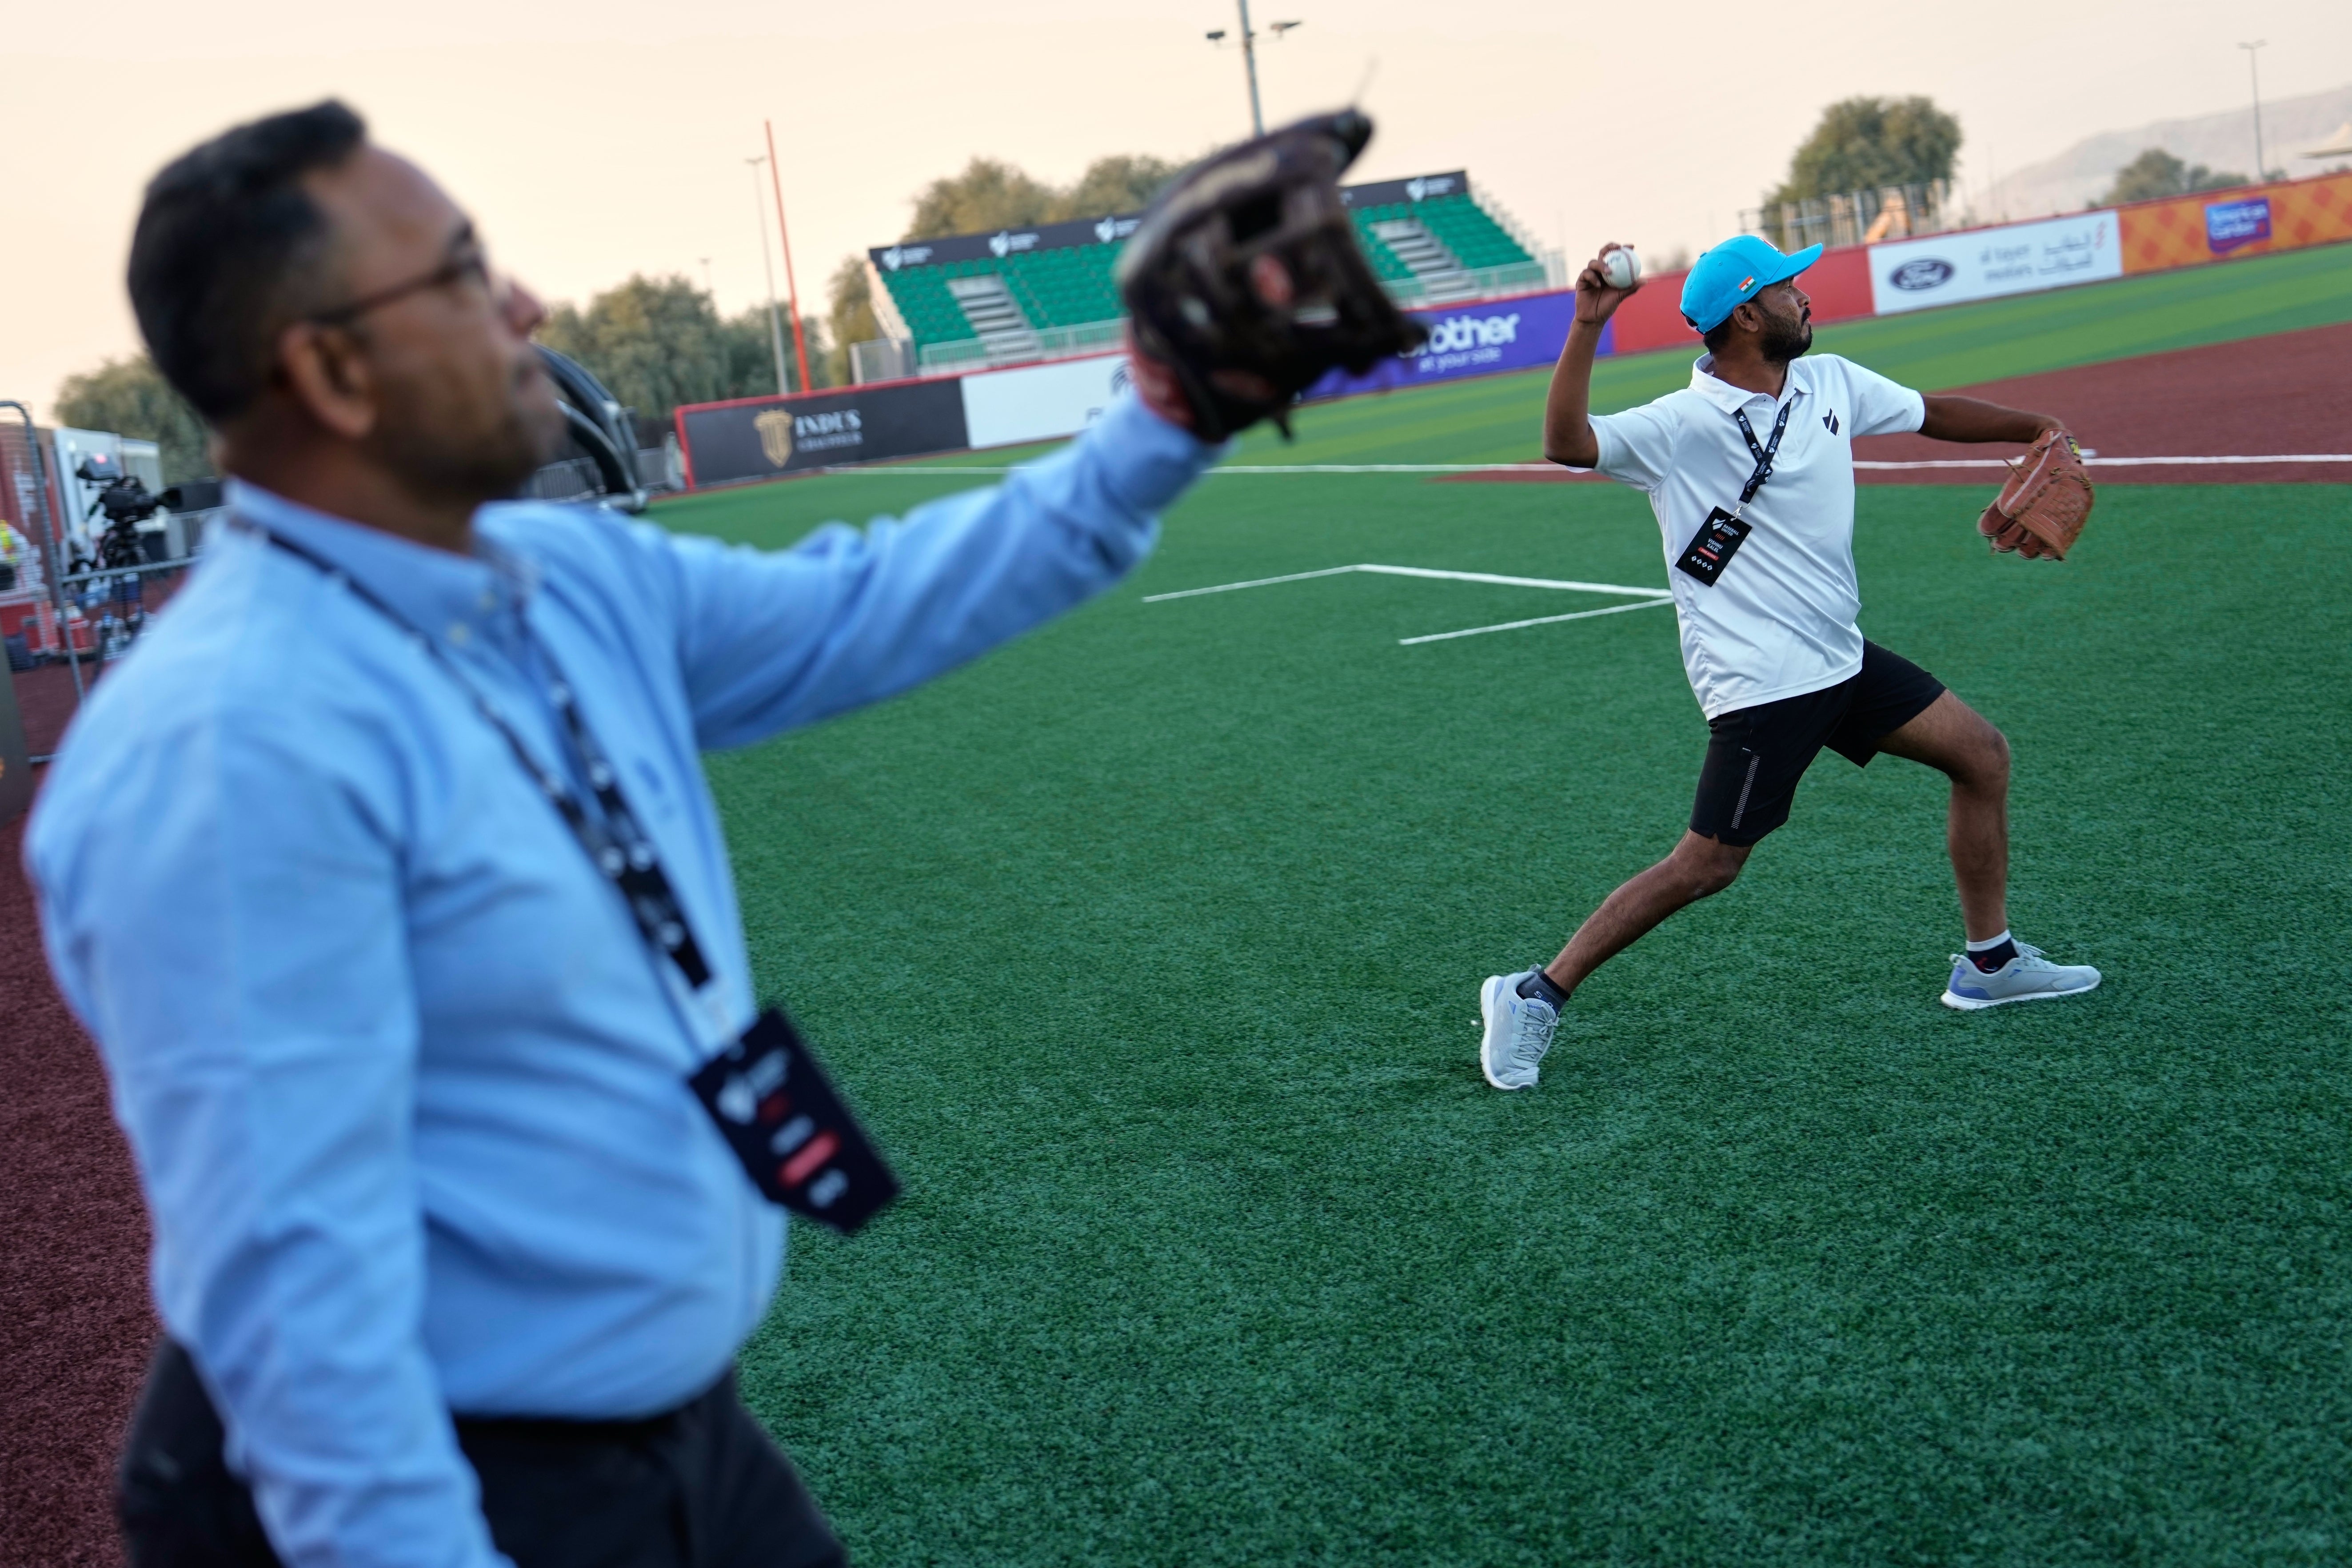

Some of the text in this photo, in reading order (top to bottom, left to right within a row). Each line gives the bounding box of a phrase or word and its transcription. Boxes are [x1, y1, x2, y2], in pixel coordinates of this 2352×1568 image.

[1899, 261, 1945, 287] Ford
[1418, 347, 1502, 374] at your side
[795, 409, 862, 438] INDUS
[1721, 527, 1733, 536] UNITED
[1723, 524, 1739, 536] BASEBALL
[1706, 543, 1719, 553] KALEL
[1708, 538, 1723, 550] VISHNU
